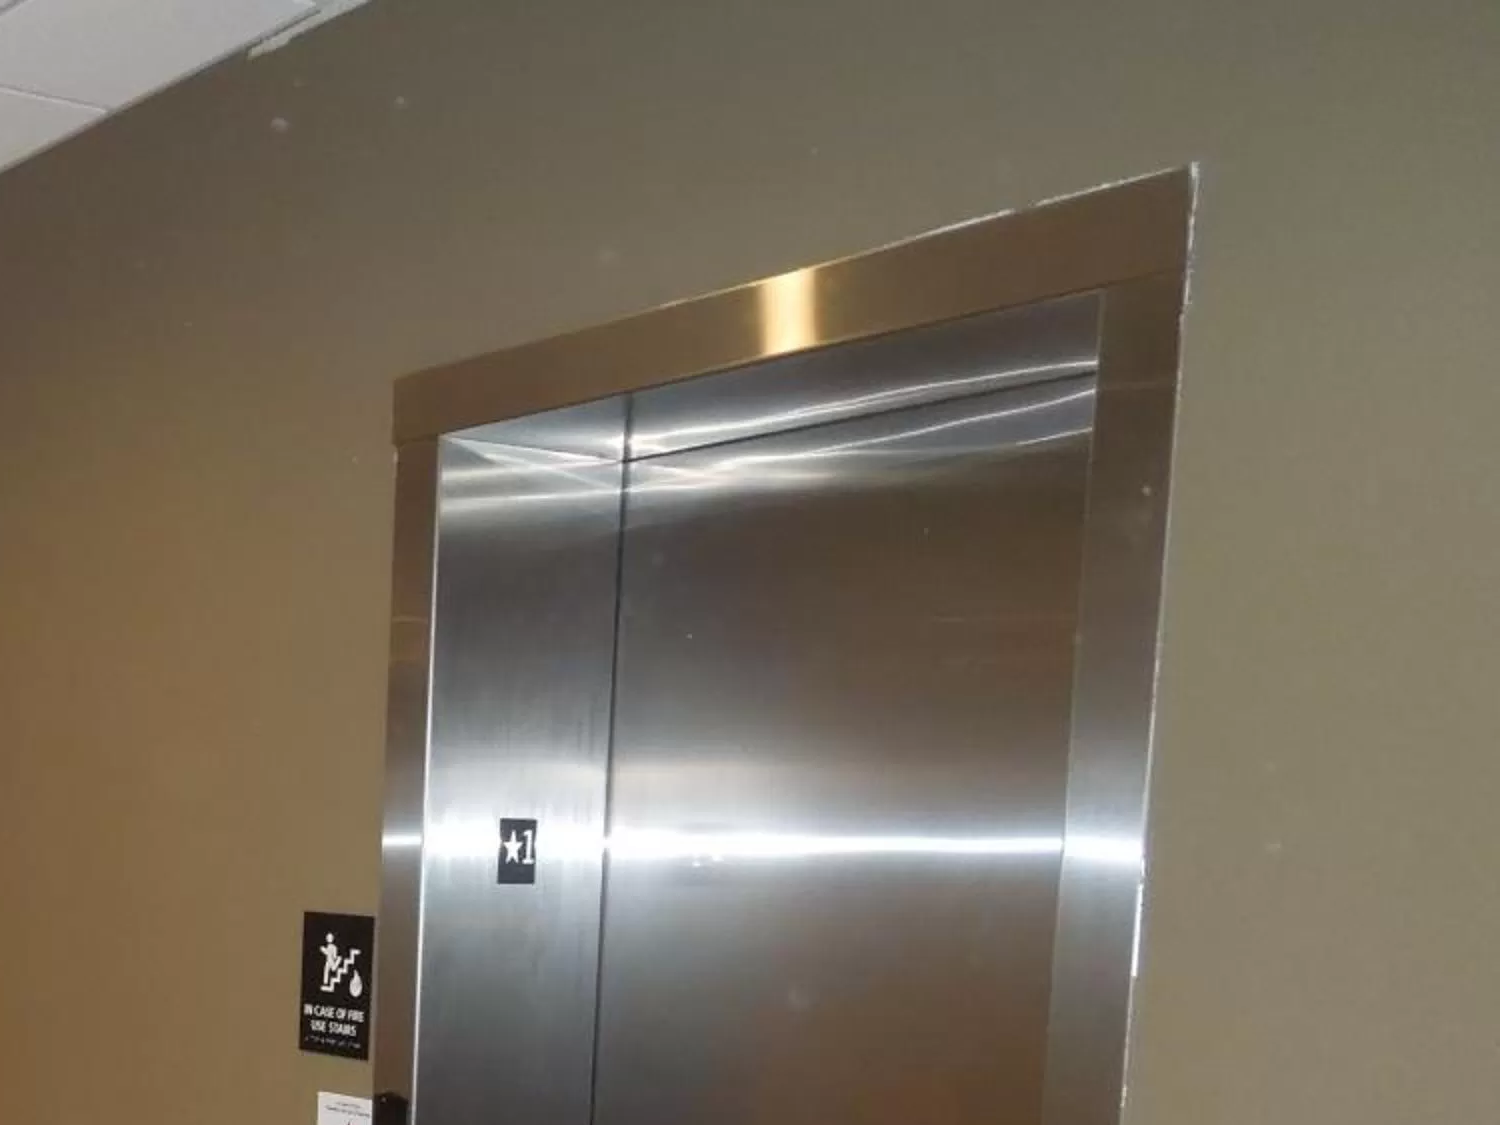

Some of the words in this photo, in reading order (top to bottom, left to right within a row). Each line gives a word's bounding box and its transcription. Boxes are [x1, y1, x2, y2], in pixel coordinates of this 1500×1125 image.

[522, 829, 535, 865] 1
[303, 1003, 313, 1016] IN
[313, 1005, 335, 1019] CASE
[336, 1007, 347, 1019] OF
[348, 1009, 365, 1023] FIRE
[310, 1019, 326, 1032] USE
[329, 1021, 357, 1037] STAIRS
